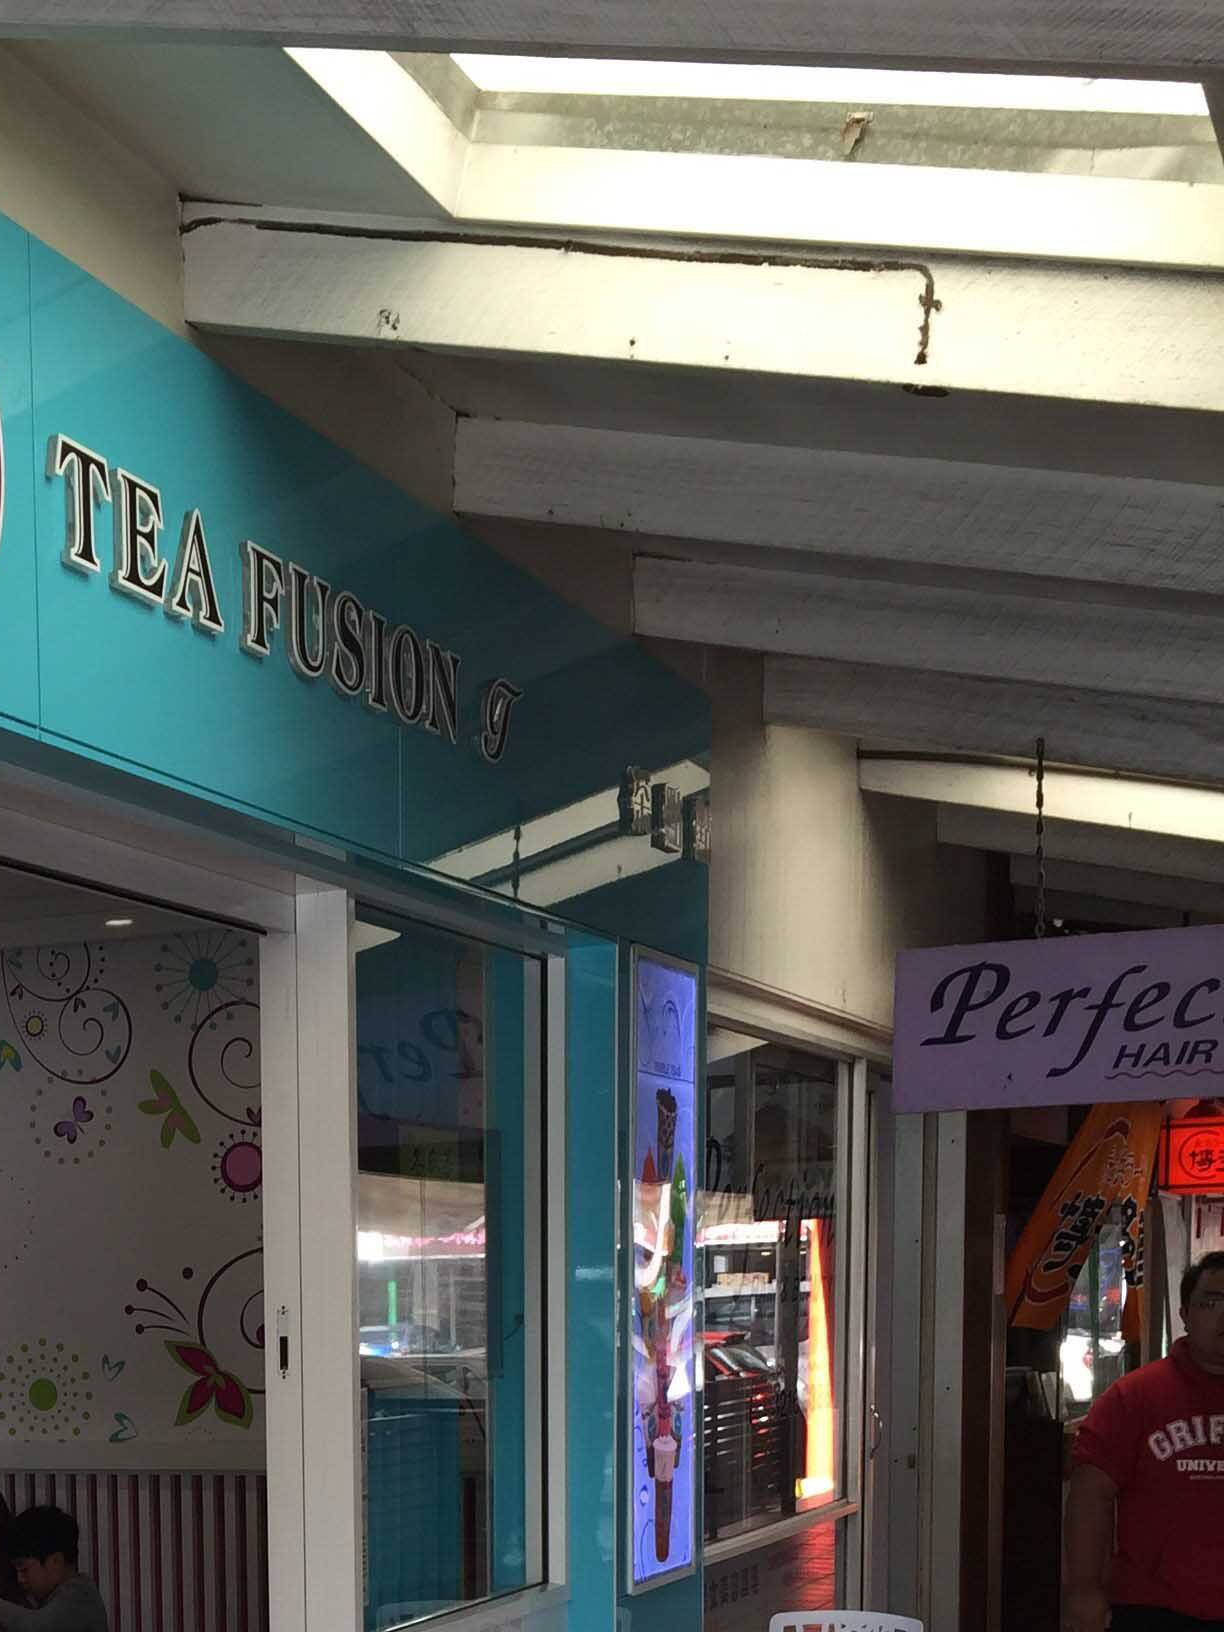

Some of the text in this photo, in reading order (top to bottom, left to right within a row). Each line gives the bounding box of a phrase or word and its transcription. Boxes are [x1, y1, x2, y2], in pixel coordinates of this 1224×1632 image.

[46, 433, 225, 634] TEA
[239, 540, 462, 744] FUSION
[920, 960, 1224, 1079] Perfec
[1112, 1039, 1219, 1070] HAIR
